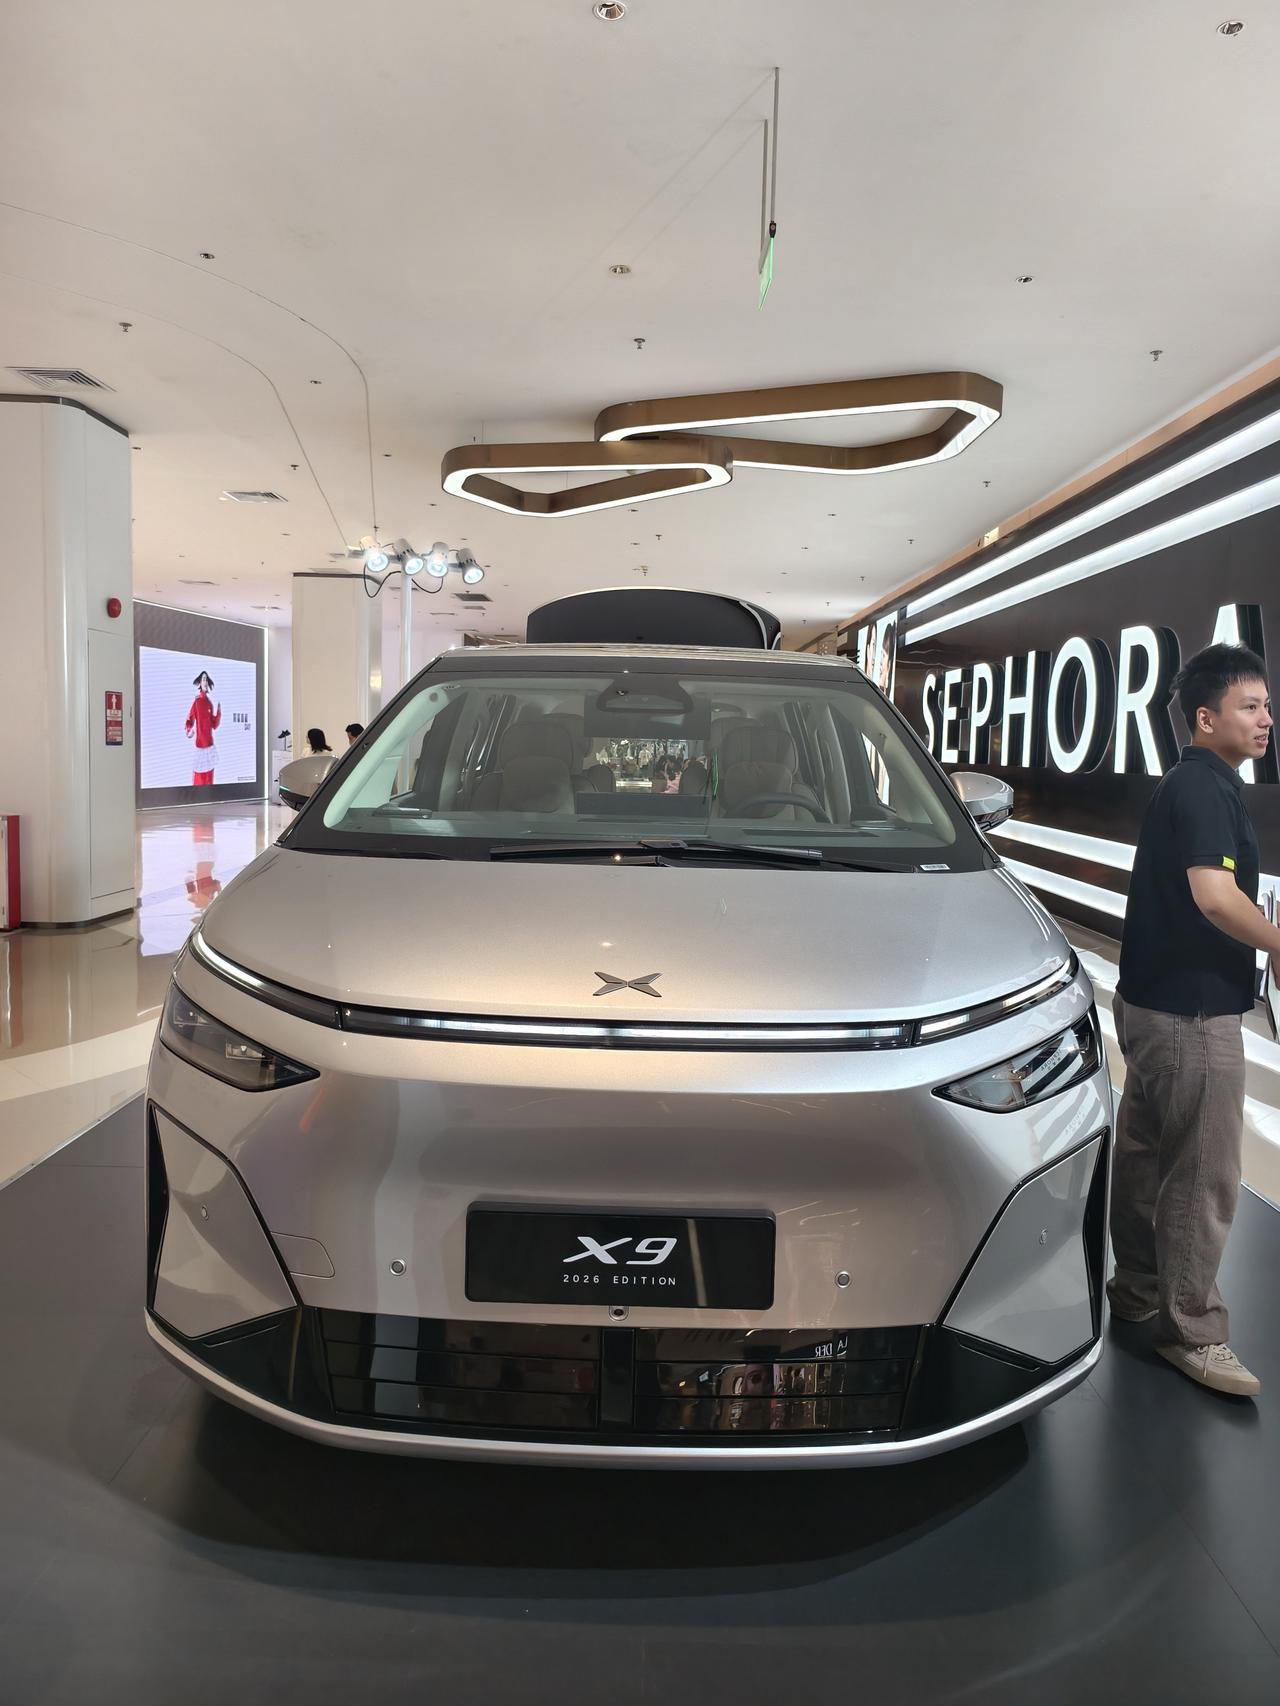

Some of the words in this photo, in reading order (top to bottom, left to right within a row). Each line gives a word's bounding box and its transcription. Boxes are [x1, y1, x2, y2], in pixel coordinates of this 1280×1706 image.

[562, 1236, 678, 1265] X9
[563, 1274, 600, 1283] 2026
[613, 1276, 676, 1286] EDITION
